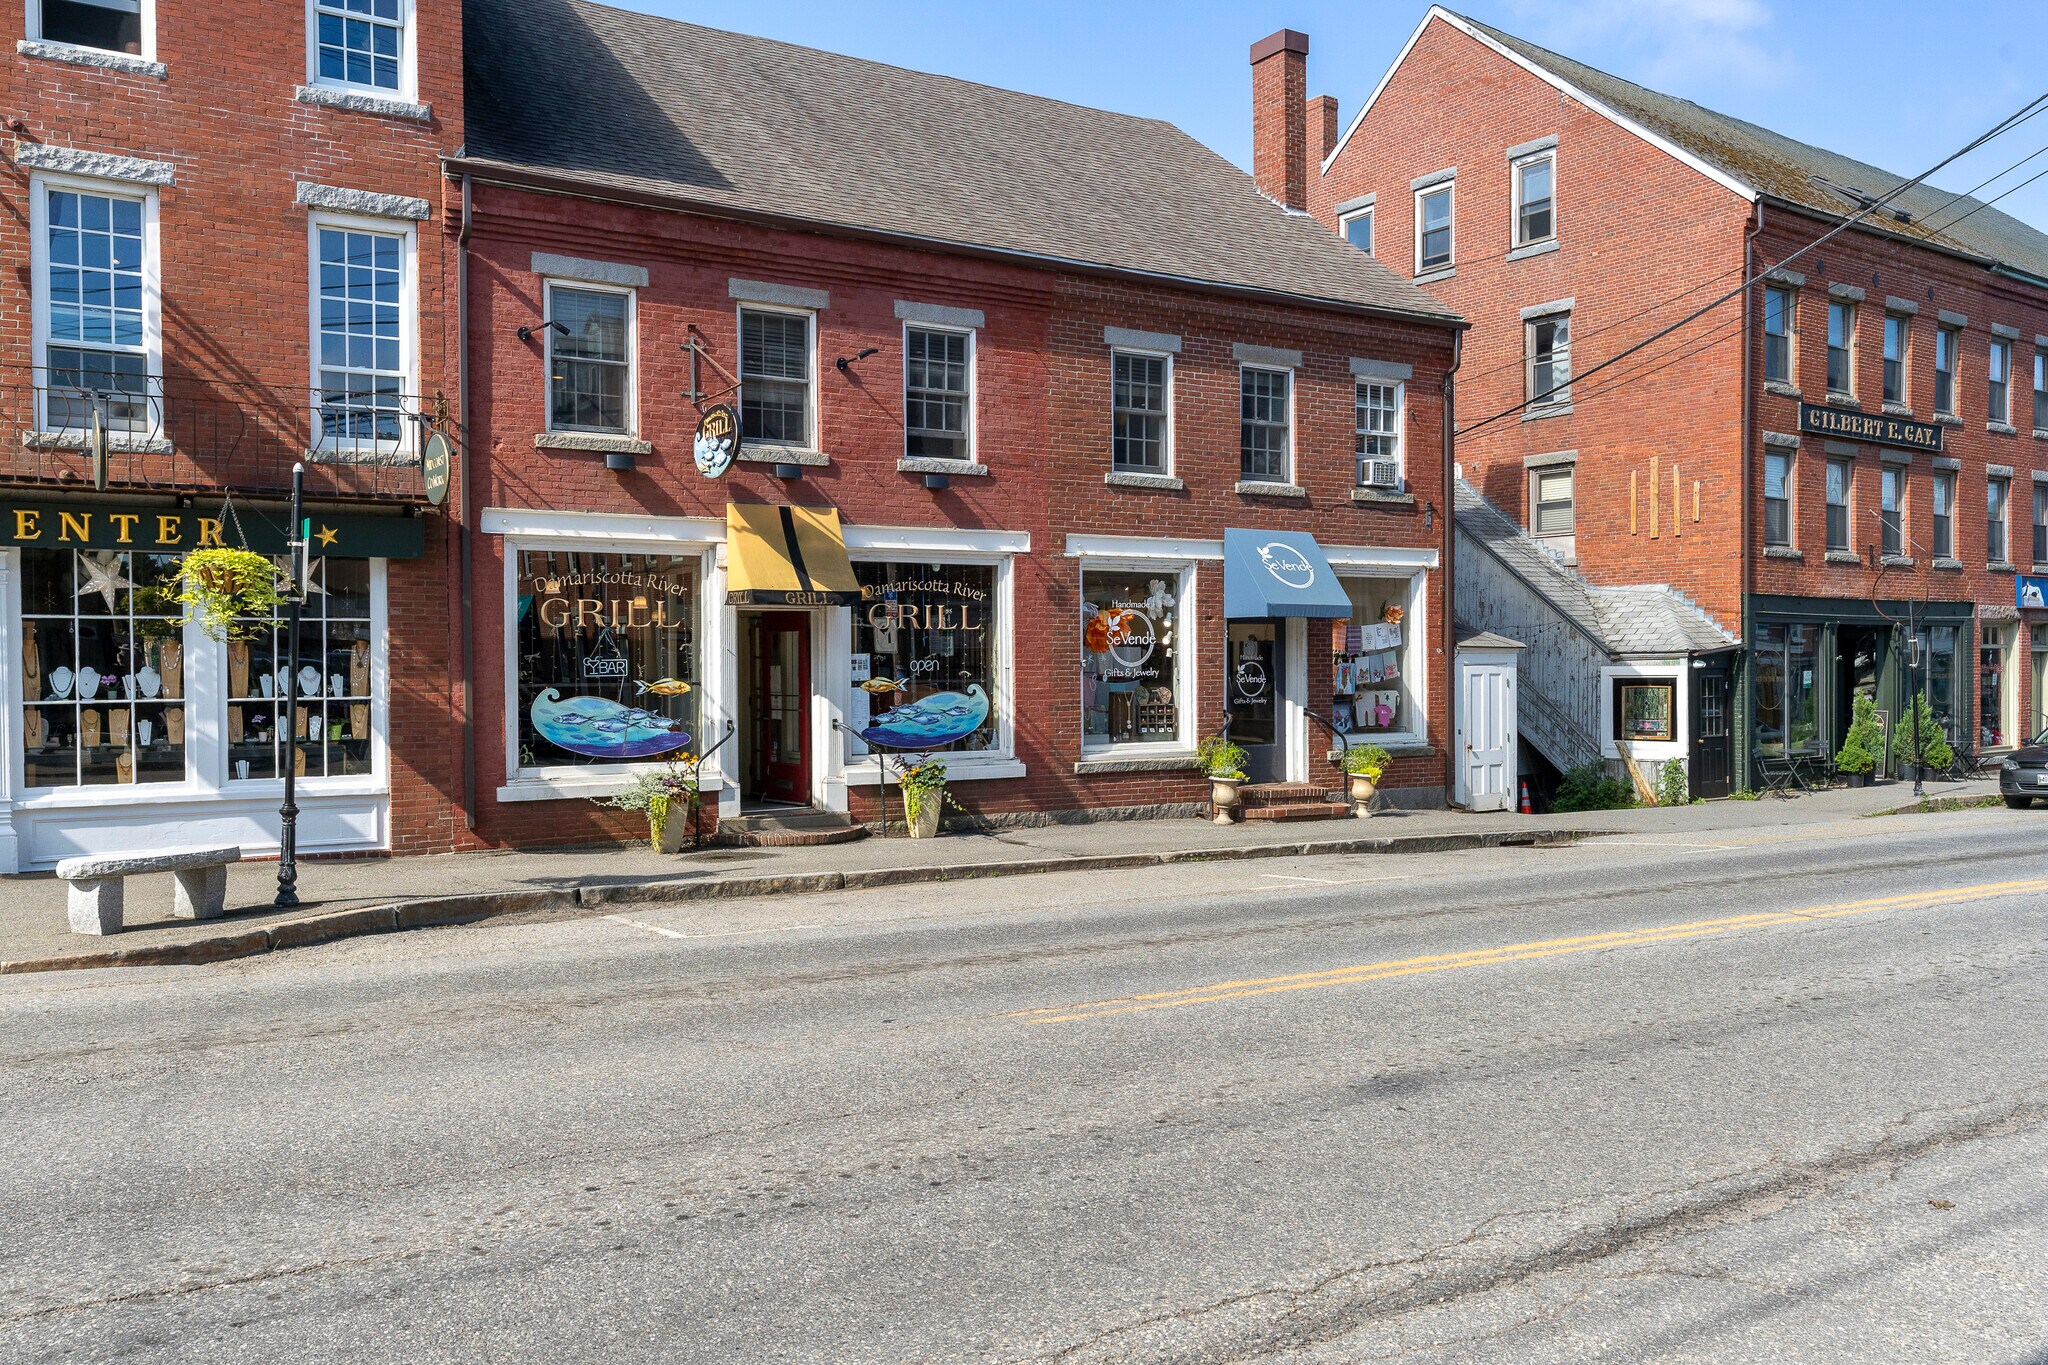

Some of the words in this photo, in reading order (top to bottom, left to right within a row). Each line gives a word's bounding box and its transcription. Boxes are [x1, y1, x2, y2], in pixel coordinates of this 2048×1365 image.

[702, 417, 732, 439] GRILL
[1809, 409, 1883, 437] GILBERT
[1888, 422, 1903, 440] E.
[12, 509, 228, 547] ENTER
[1261, 557, 1314, 573] SeVende
[532, 568, 643, 592] Damariscotta
[646, 573, 688, 596] River
[862, 576, 950, 598] Damariscotta
[953, 581, 988, 602] River
[728, 591, 750, 604] GRILL
[785, 592, 834, 605] GRILL
[1111, 599, 1151, 609] Handmade
[540, 597, 681, 628] GRILL
[868, 603, 982, 630] GRILL
[1106, 631, 1157, 645] SeVende
[598, 661, 625, 674] BAR
[909, 659, 940, 674] open
[1104, 668, 1124, 678] Gifts
[1125, 668, 1133, 677] &
[1132, 667, 1160, 679] Jewelry
[1251, 697, 1267, 705] Jewelry
